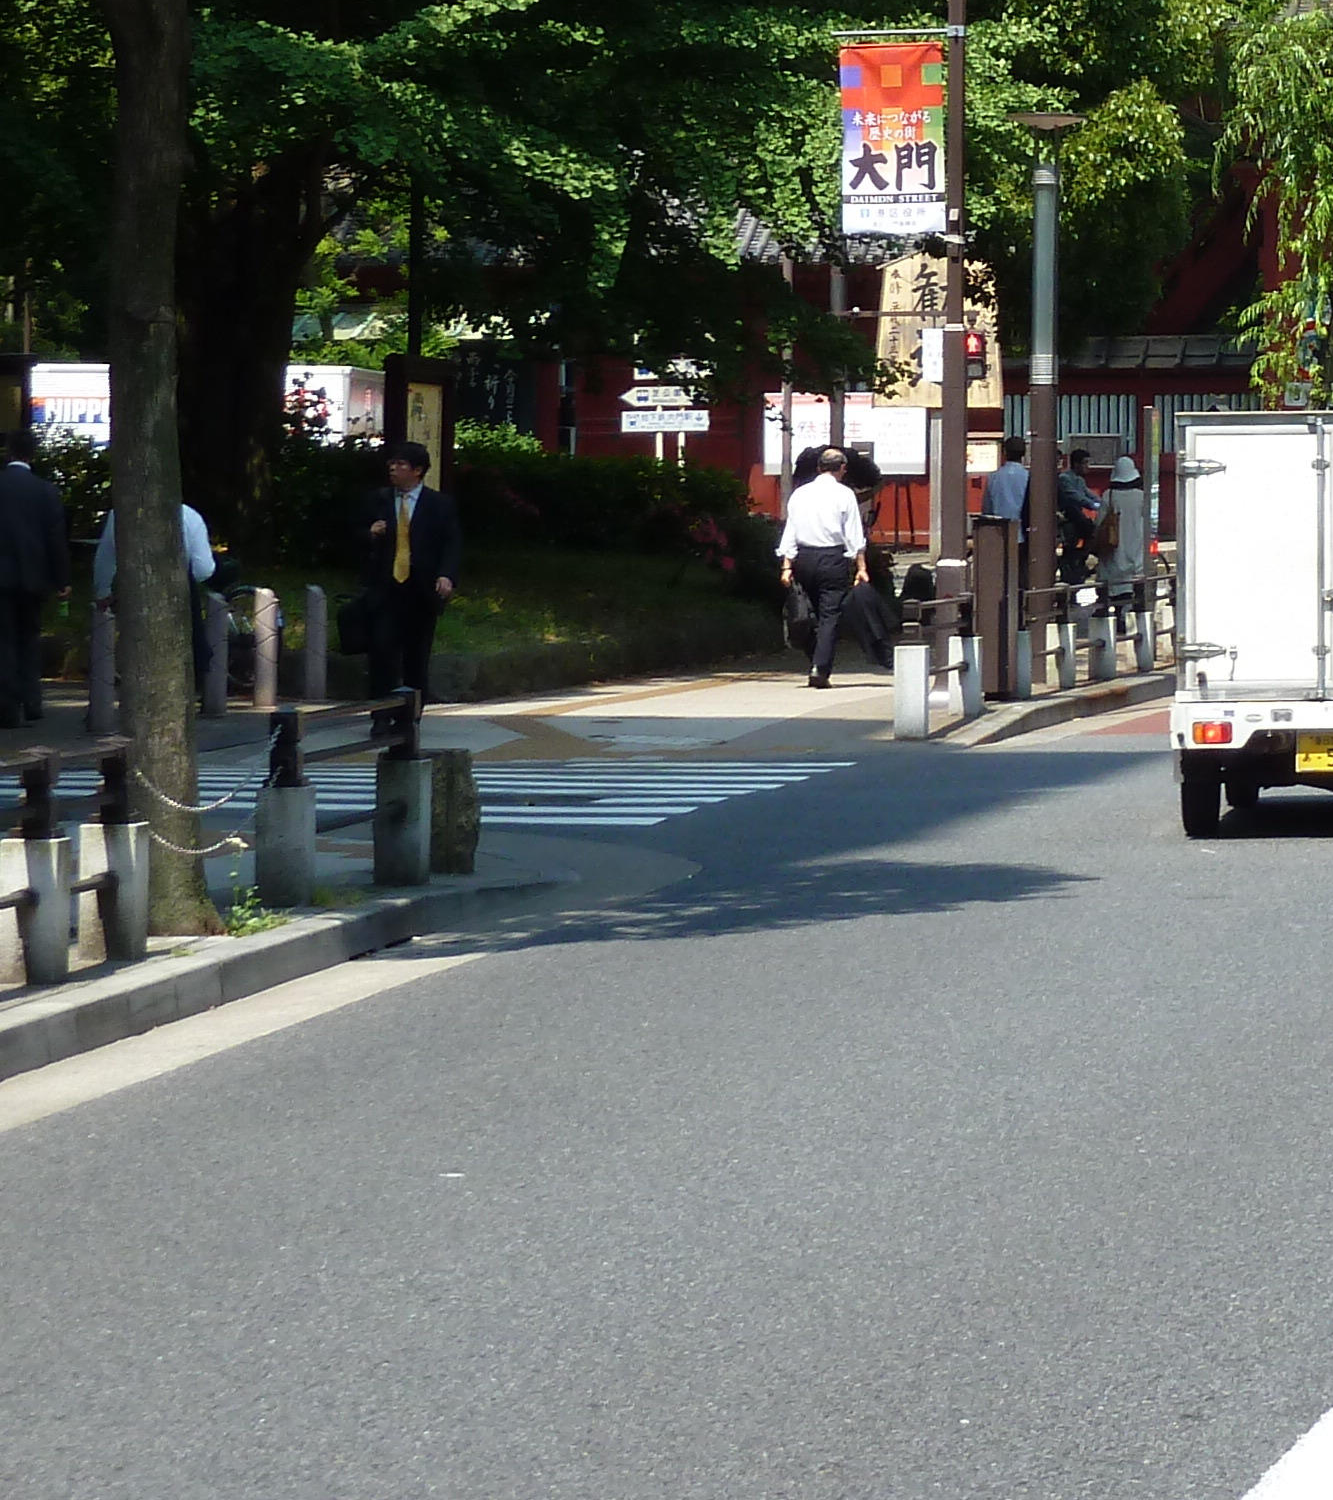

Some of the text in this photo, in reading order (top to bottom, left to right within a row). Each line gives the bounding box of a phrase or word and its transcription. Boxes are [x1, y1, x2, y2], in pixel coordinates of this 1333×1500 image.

[852, 111, 931, 126] 未来につながる
[869, 126, 916, 140] 歴史の街
[849, 141, 937, 191] 大門
[850, 194, 938, 204] DAIMON STREET
